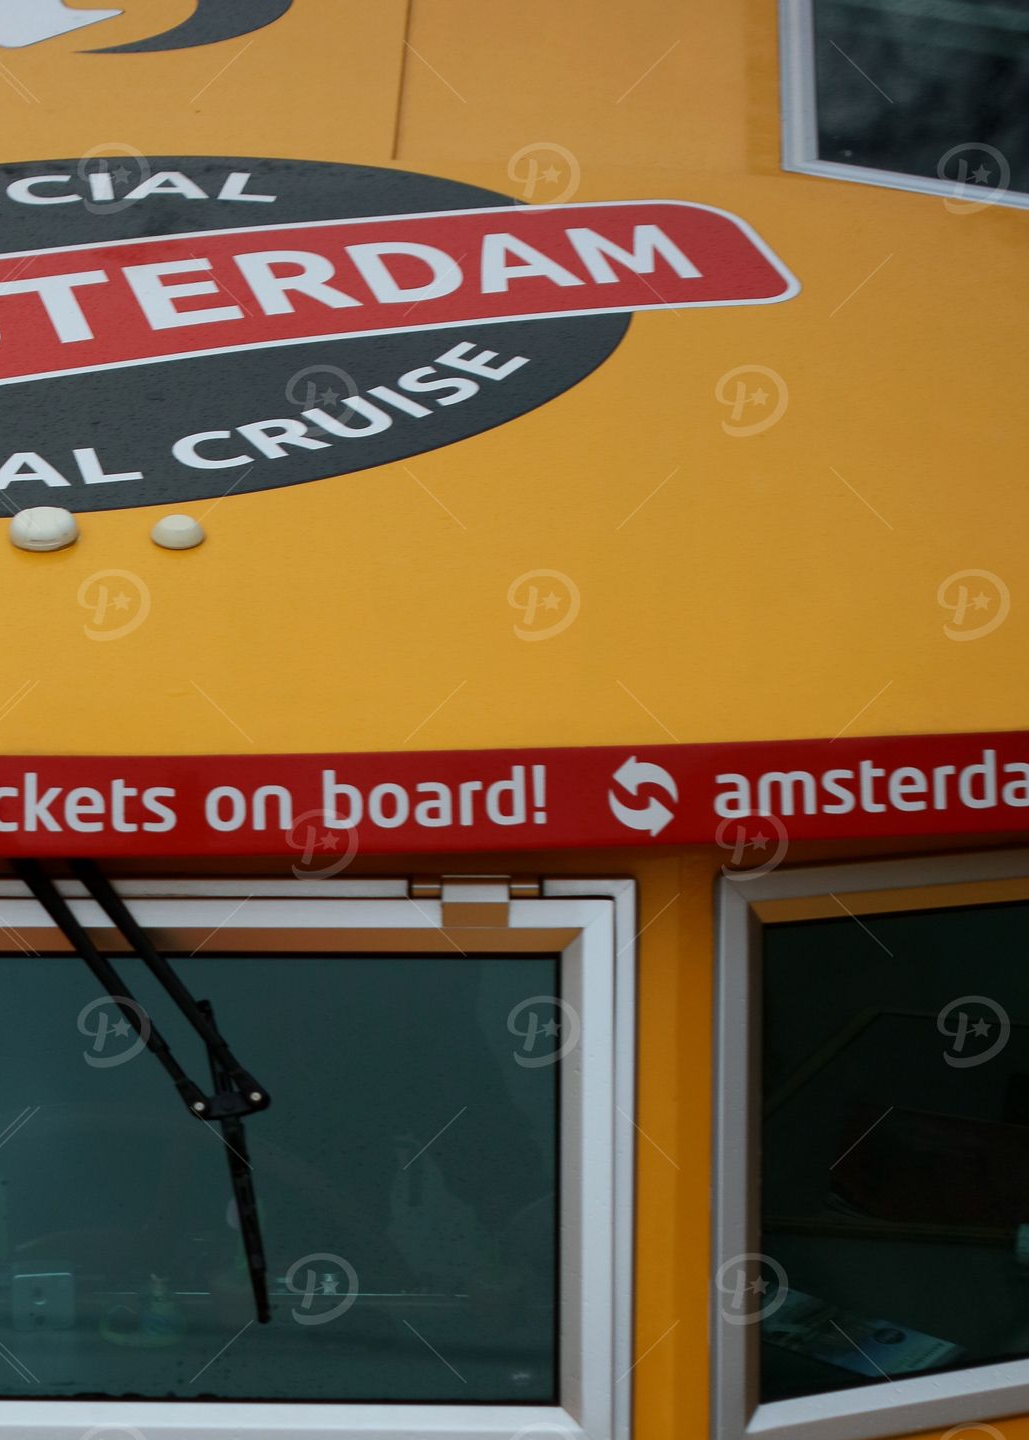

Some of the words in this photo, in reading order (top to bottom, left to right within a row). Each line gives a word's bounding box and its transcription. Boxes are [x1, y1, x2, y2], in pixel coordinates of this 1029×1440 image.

[171, 340, 531, 471] CRUISE
[205, 784, 294, 832] on
[322, 763, 547, 830] board!
[714, 747, 1029, 819] amsterda
